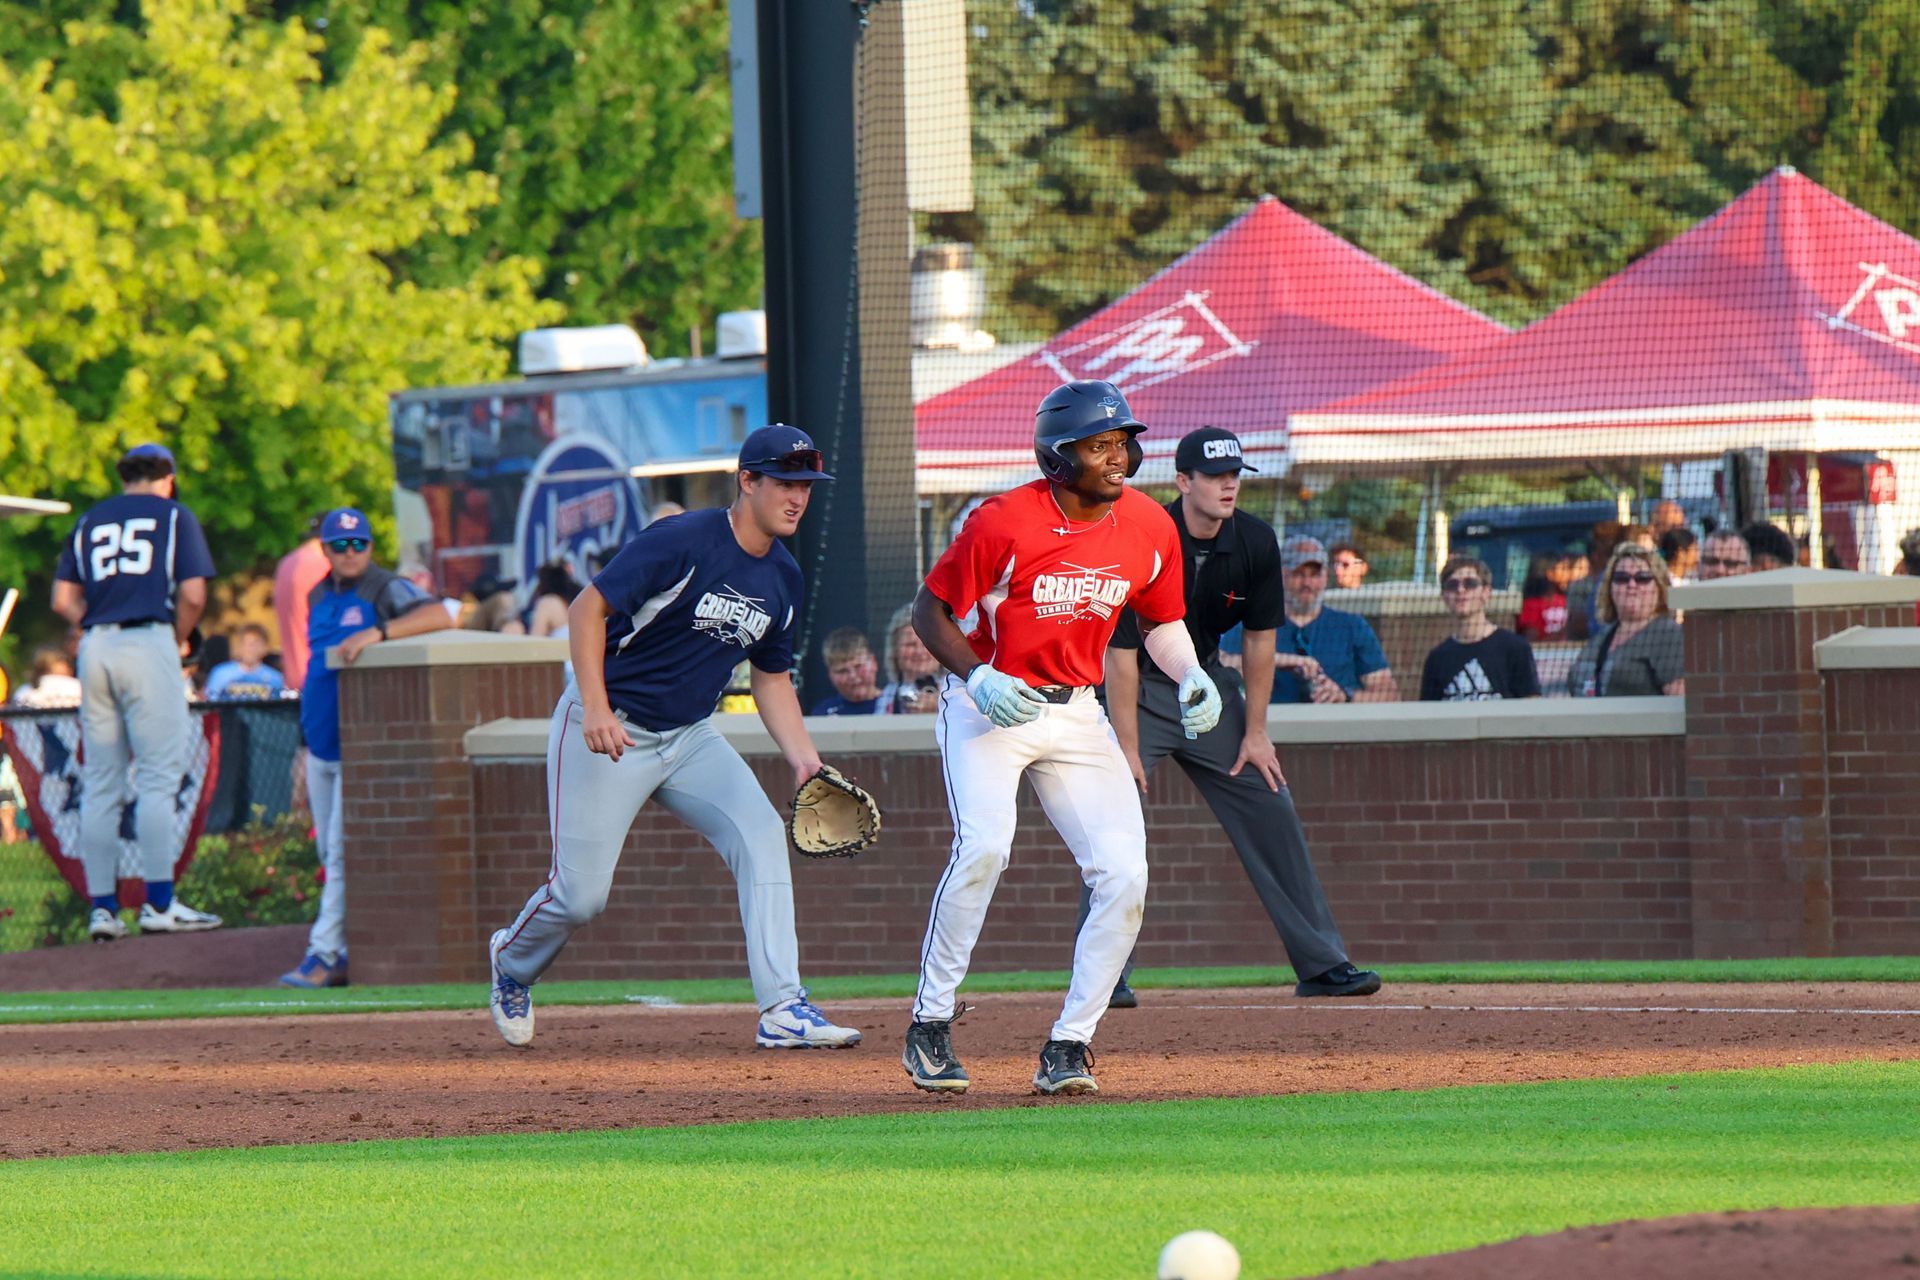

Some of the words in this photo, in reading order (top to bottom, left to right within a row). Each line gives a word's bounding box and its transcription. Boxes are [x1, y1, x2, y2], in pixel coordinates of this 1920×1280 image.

[90, 518, 156, 581] 25
[1032, 575, 1083, 603] GREAT
[695, 592, 738, 619] GREAT
